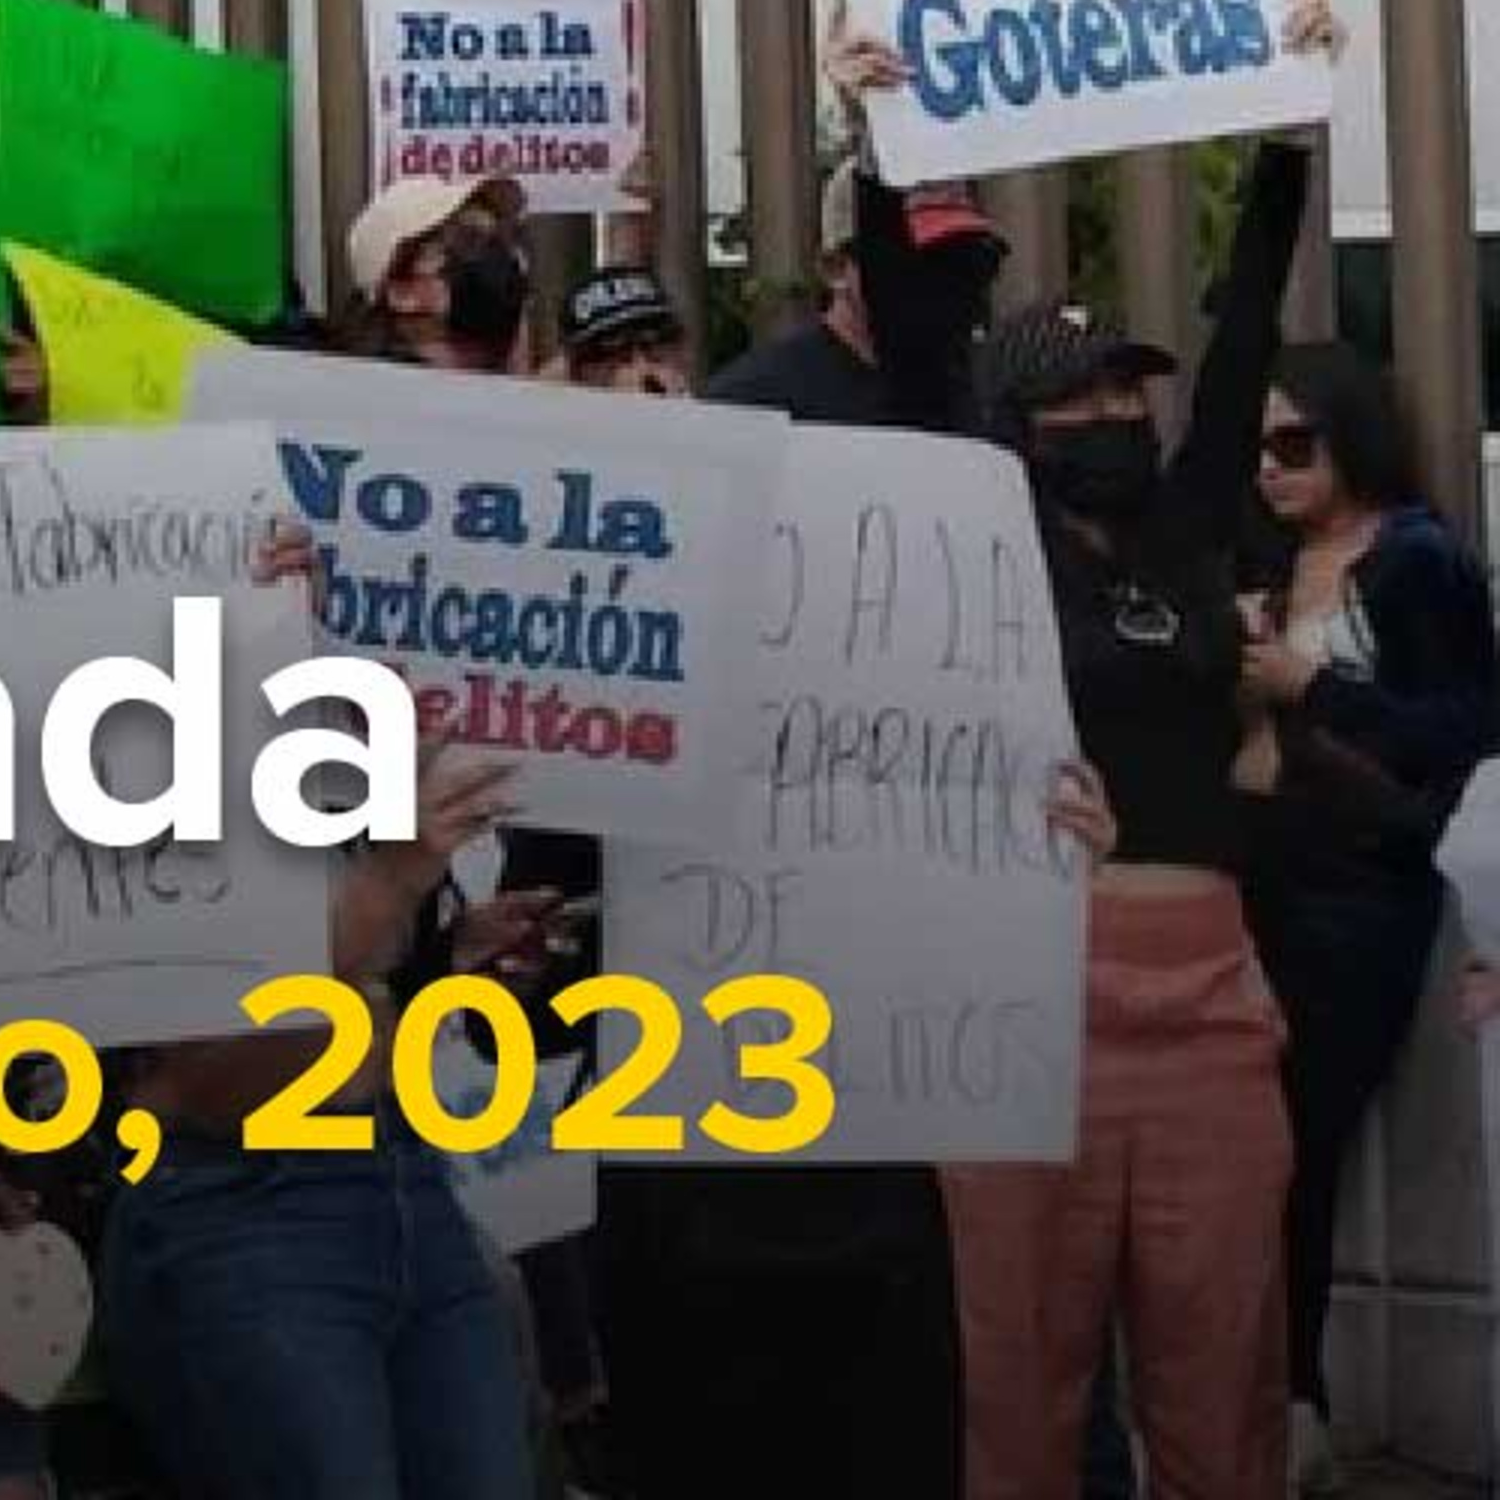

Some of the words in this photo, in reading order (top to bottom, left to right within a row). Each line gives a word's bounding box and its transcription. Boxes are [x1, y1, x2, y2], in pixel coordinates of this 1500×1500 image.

[397, 11, 483, 61] No
[495, 27, 529, 60] a
[539, 11, 592, 60] la
[401, 64, 611, 129] fabricación
[401, 136, 452, 177] de
[459, 135, 611, 176] delitos
[450, 478, 529, 550] a
[545, 469, 674, 560] la
[316, 546, 685, 684] bricación
[380, 663, 679, 765] elitos
